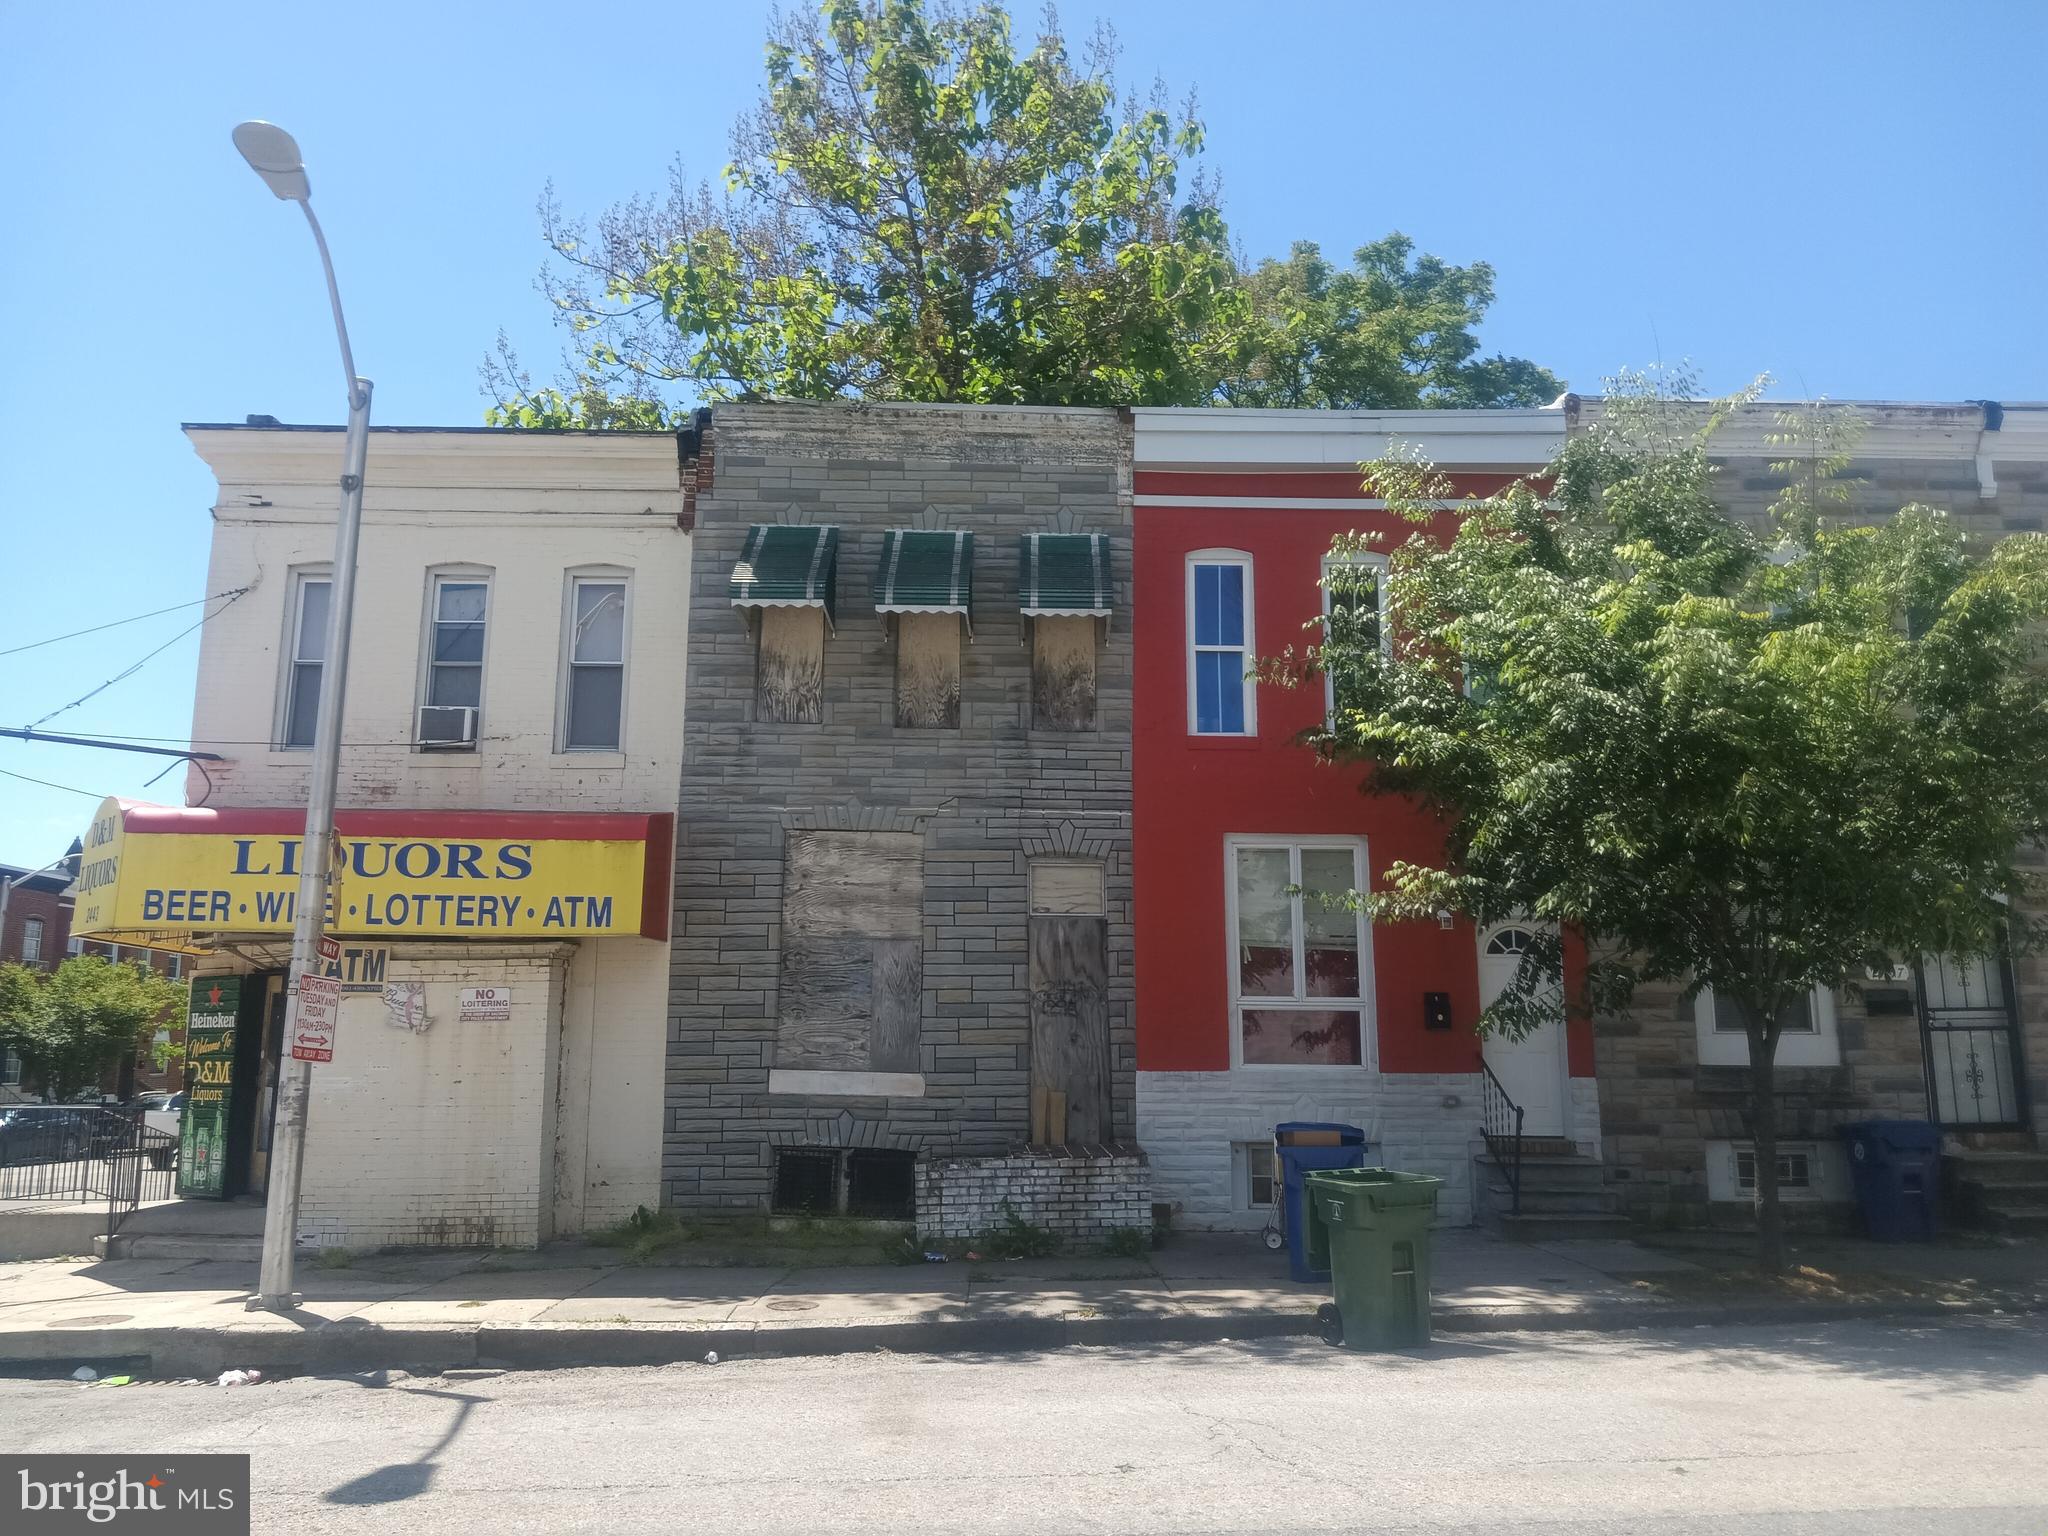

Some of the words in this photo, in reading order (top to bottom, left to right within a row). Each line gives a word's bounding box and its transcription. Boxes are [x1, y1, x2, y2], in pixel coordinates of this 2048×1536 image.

[79, 856, 118, 896] LIQUORS
[143, 889, 231, 922] BEER
[256, 891, 333, 924] WI
[365, 893, 521, 927] LOTTERY
[542, 896, 613, 928] ATM
[322, 941, 338, 957] WAY
[301, 975, 310, 990] NO
[311, 979, 339, 995] PARKING
[301, 991, 326, 1006] TUESDAY
[325, 998, 336, 1008] AND
[475, 989, 496, 1000] NO
[305, 1005, 326, 1018] FRIDAY
[462, 1000, 509, 1008] LOITERING
[190, 1012, 236, 1029] Heineken
[190, 1085, 223, 1106] Liquors
